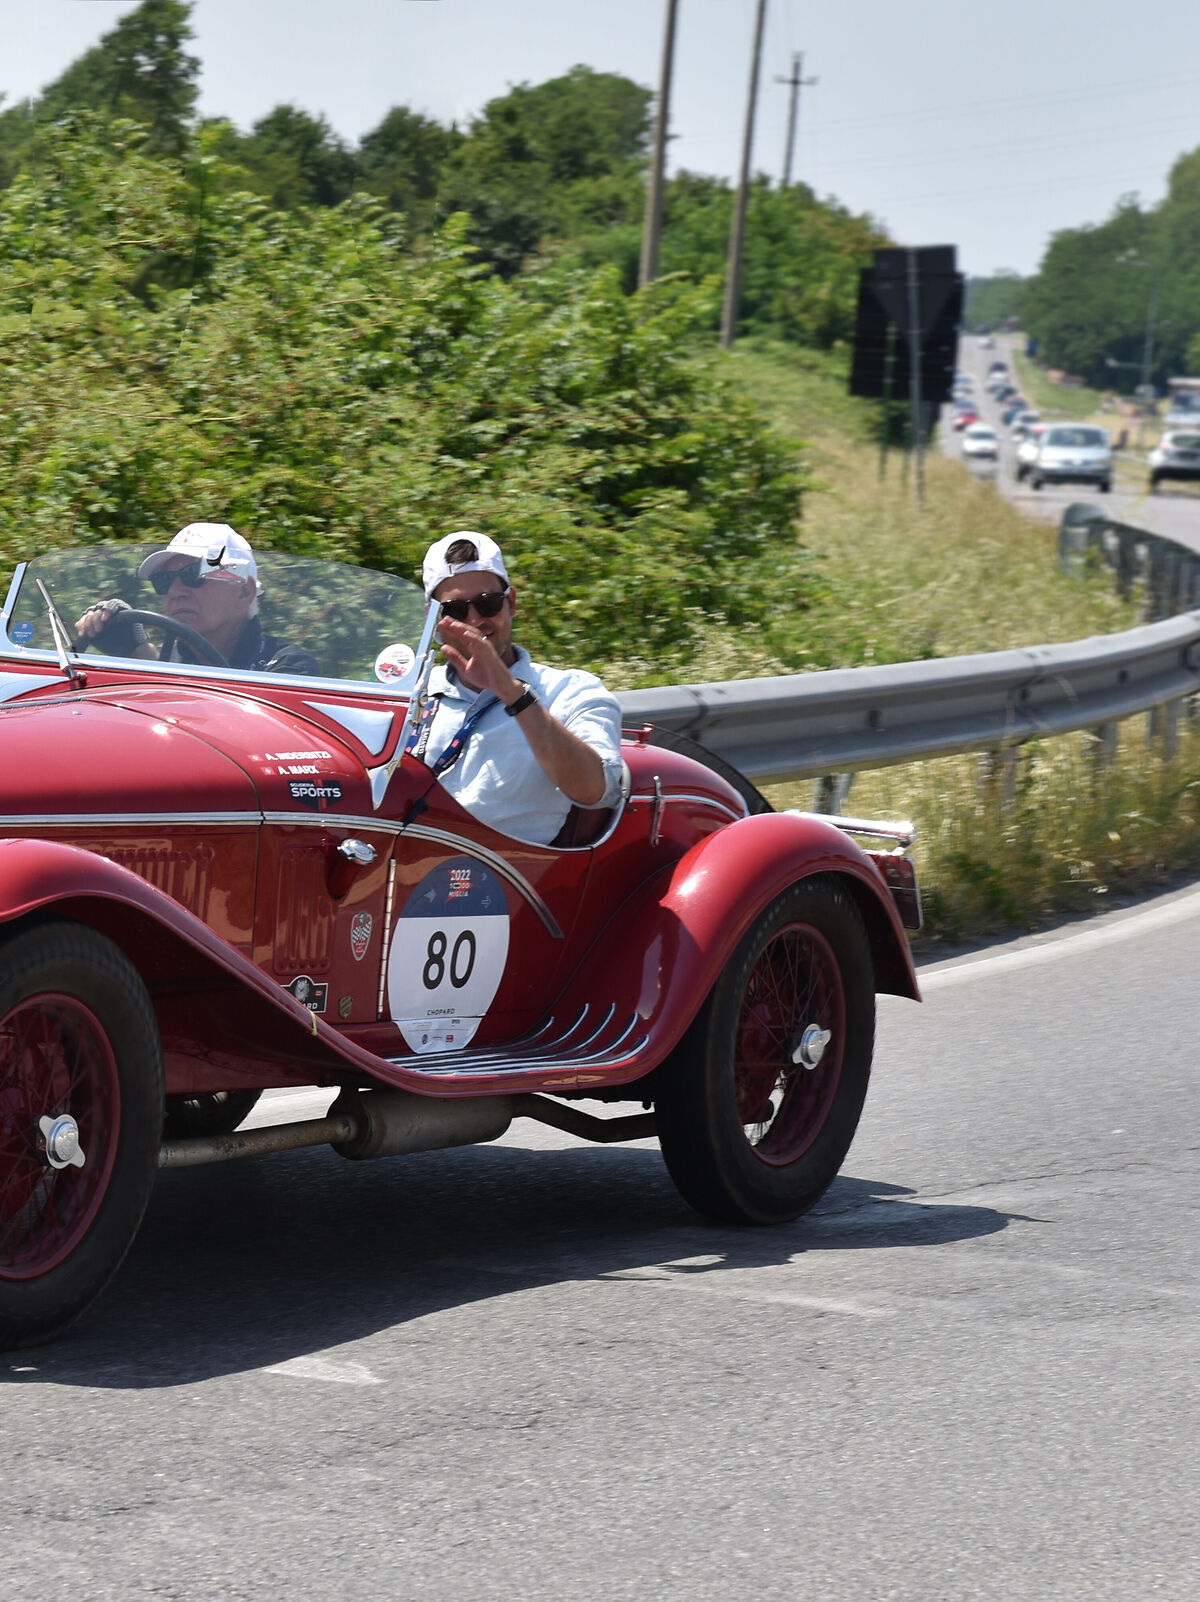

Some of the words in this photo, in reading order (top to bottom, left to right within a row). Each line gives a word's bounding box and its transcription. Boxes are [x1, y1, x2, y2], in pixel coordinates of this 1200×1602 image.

[278, 765, 290, 774] A.
[288, 765, 319, 774] MARX
[291, 787, 342, 798] SPORTS
[450, 869, 471, 881] 2022
[423, 929, 477, 991] 80
[426, 1008, 456, 1016] CHOPARD
